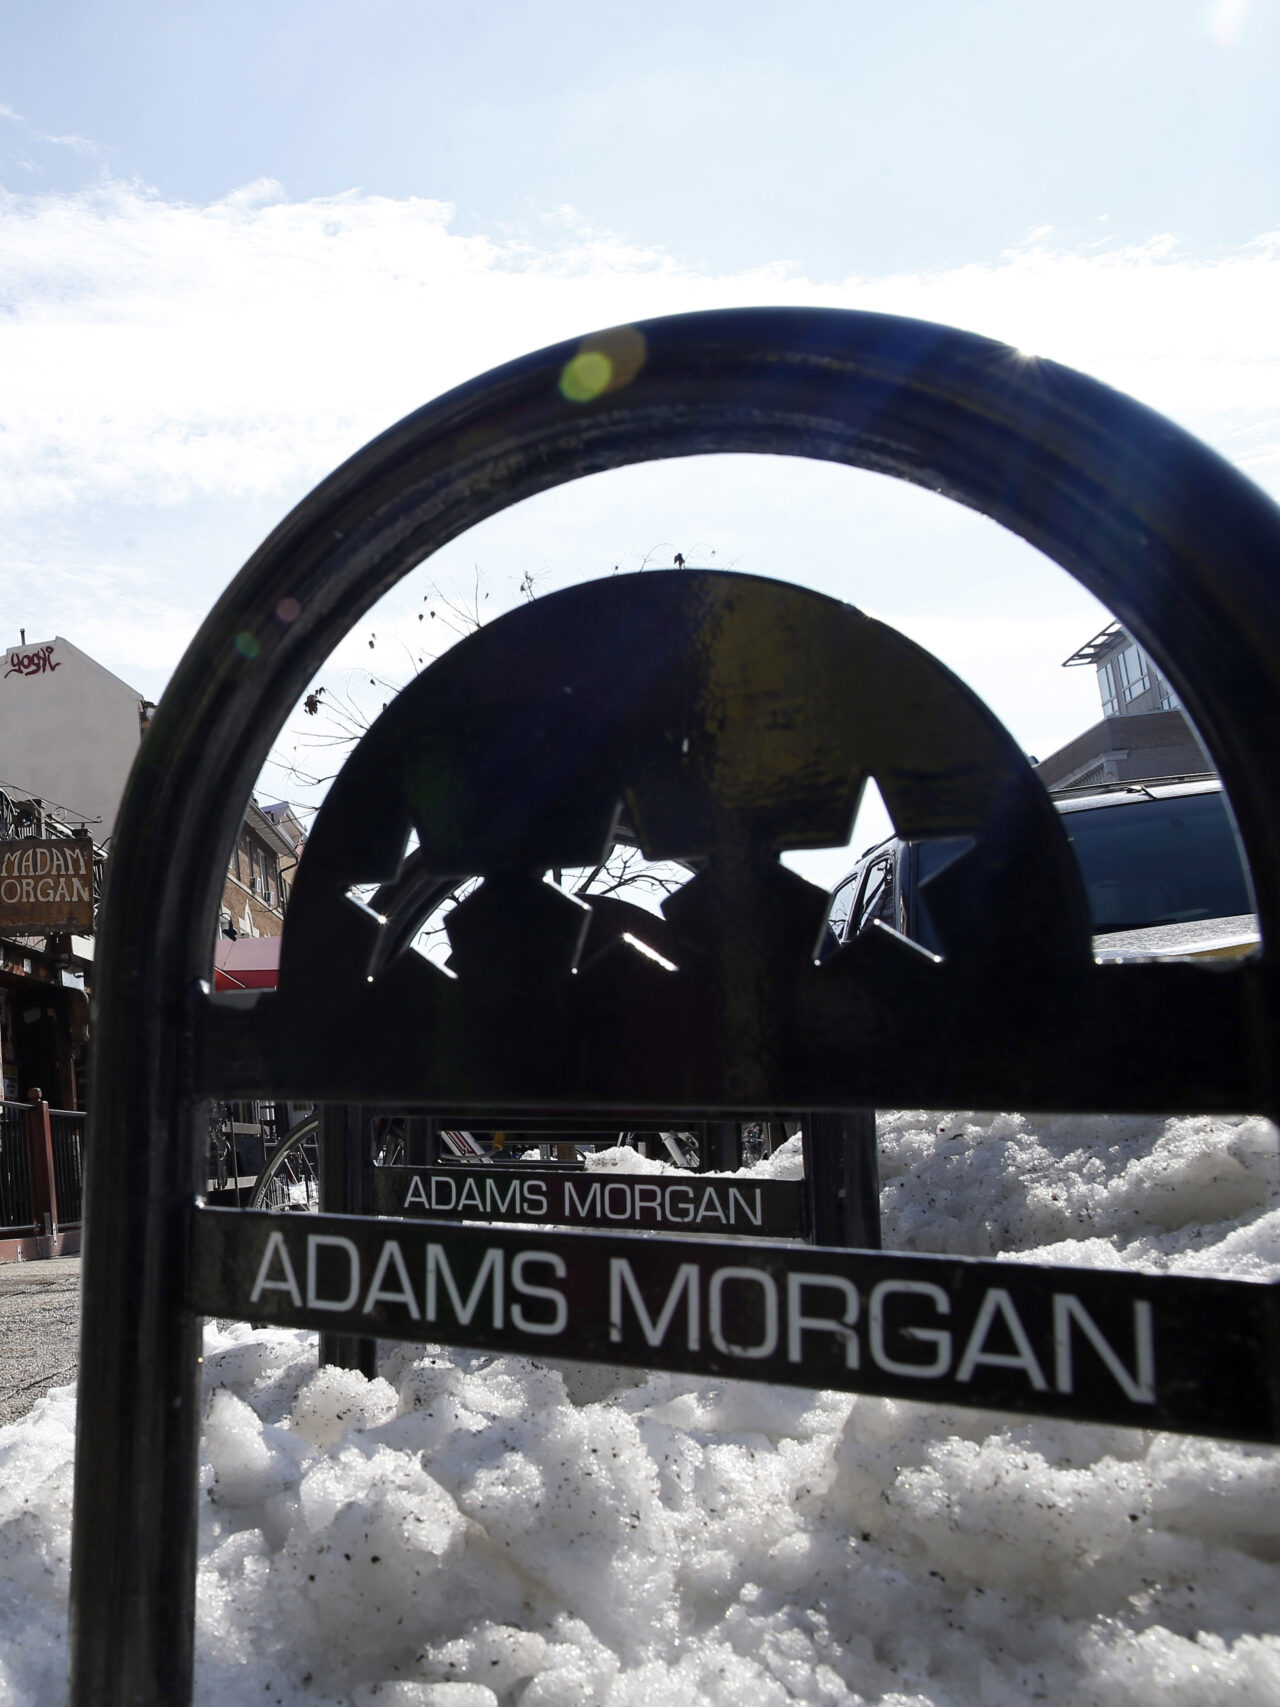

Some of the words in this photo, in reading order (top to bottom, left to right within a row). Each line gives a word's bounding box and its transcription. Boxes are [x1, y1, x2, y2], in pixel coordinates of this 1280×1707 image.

[1, 877, 90, 904] ORGAN
[404, 1176, 548, 1216] ADAMS
[565, 1182, 762, 1226] MORGAN
[250, 1231, 568, 1337] ADAMS
[608, 1257, 1156, 1402] MORGAN
